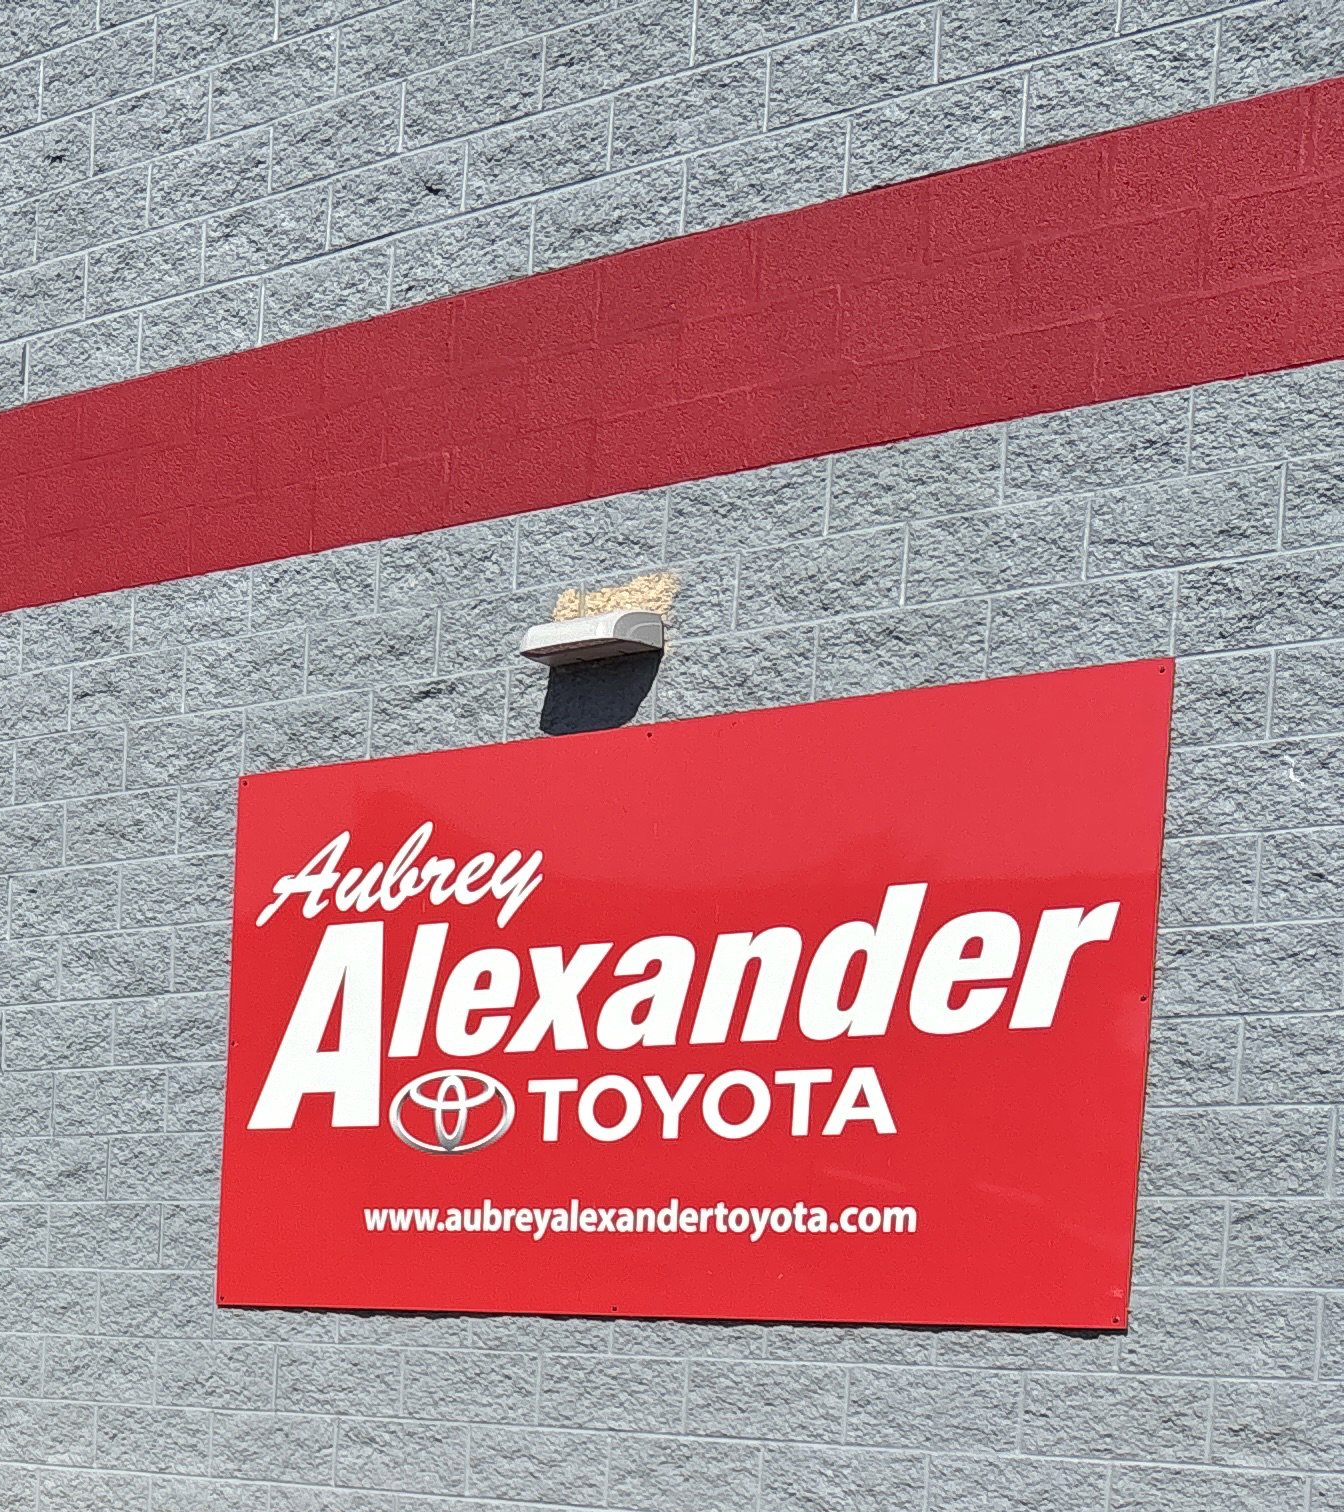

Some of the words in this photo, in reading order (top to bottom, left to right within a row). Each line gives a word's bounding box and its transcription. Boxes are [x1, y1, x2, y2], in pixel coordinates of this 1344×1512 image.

[256, 822, 543, 928] Aubrey
[248, 883, 1121, 1130] Alexander
[528, 1067, 897, 1143] TOYOTA
[364, 1199, 917, 1242] www.aubreyalexandertoyota.com
